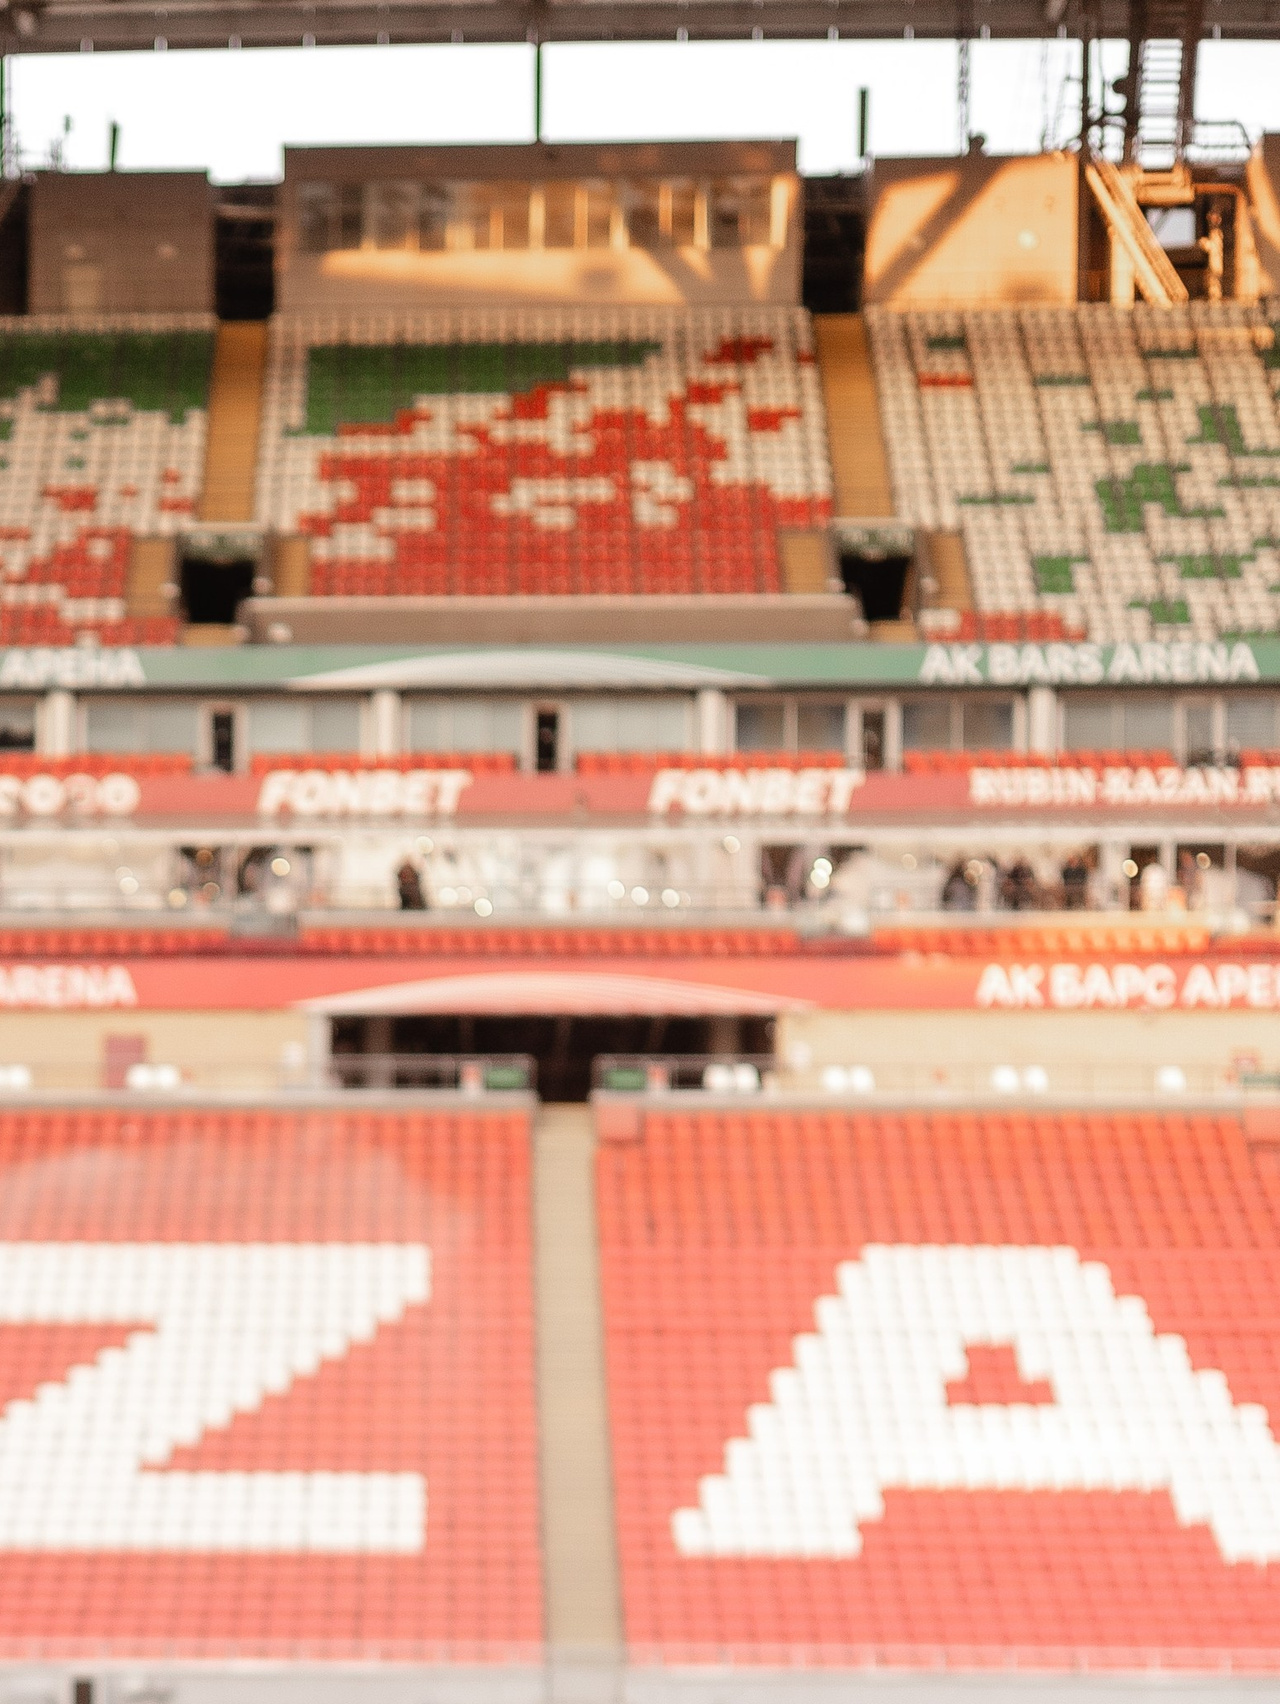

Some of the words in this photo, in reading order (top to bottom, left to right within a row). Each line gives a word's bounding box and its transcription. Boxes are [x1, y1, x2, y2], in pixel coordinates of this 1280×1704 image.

[920, 644, 984, 685] AK
[988, 644, 1105, 685] BARS
[1108, 643, 1261, 684] ARENA
[261, 769, 472, 814] FONBET
[649, 768, 865, 814] FONBET
[1180, 963, 1280, 1008] АРЕ
